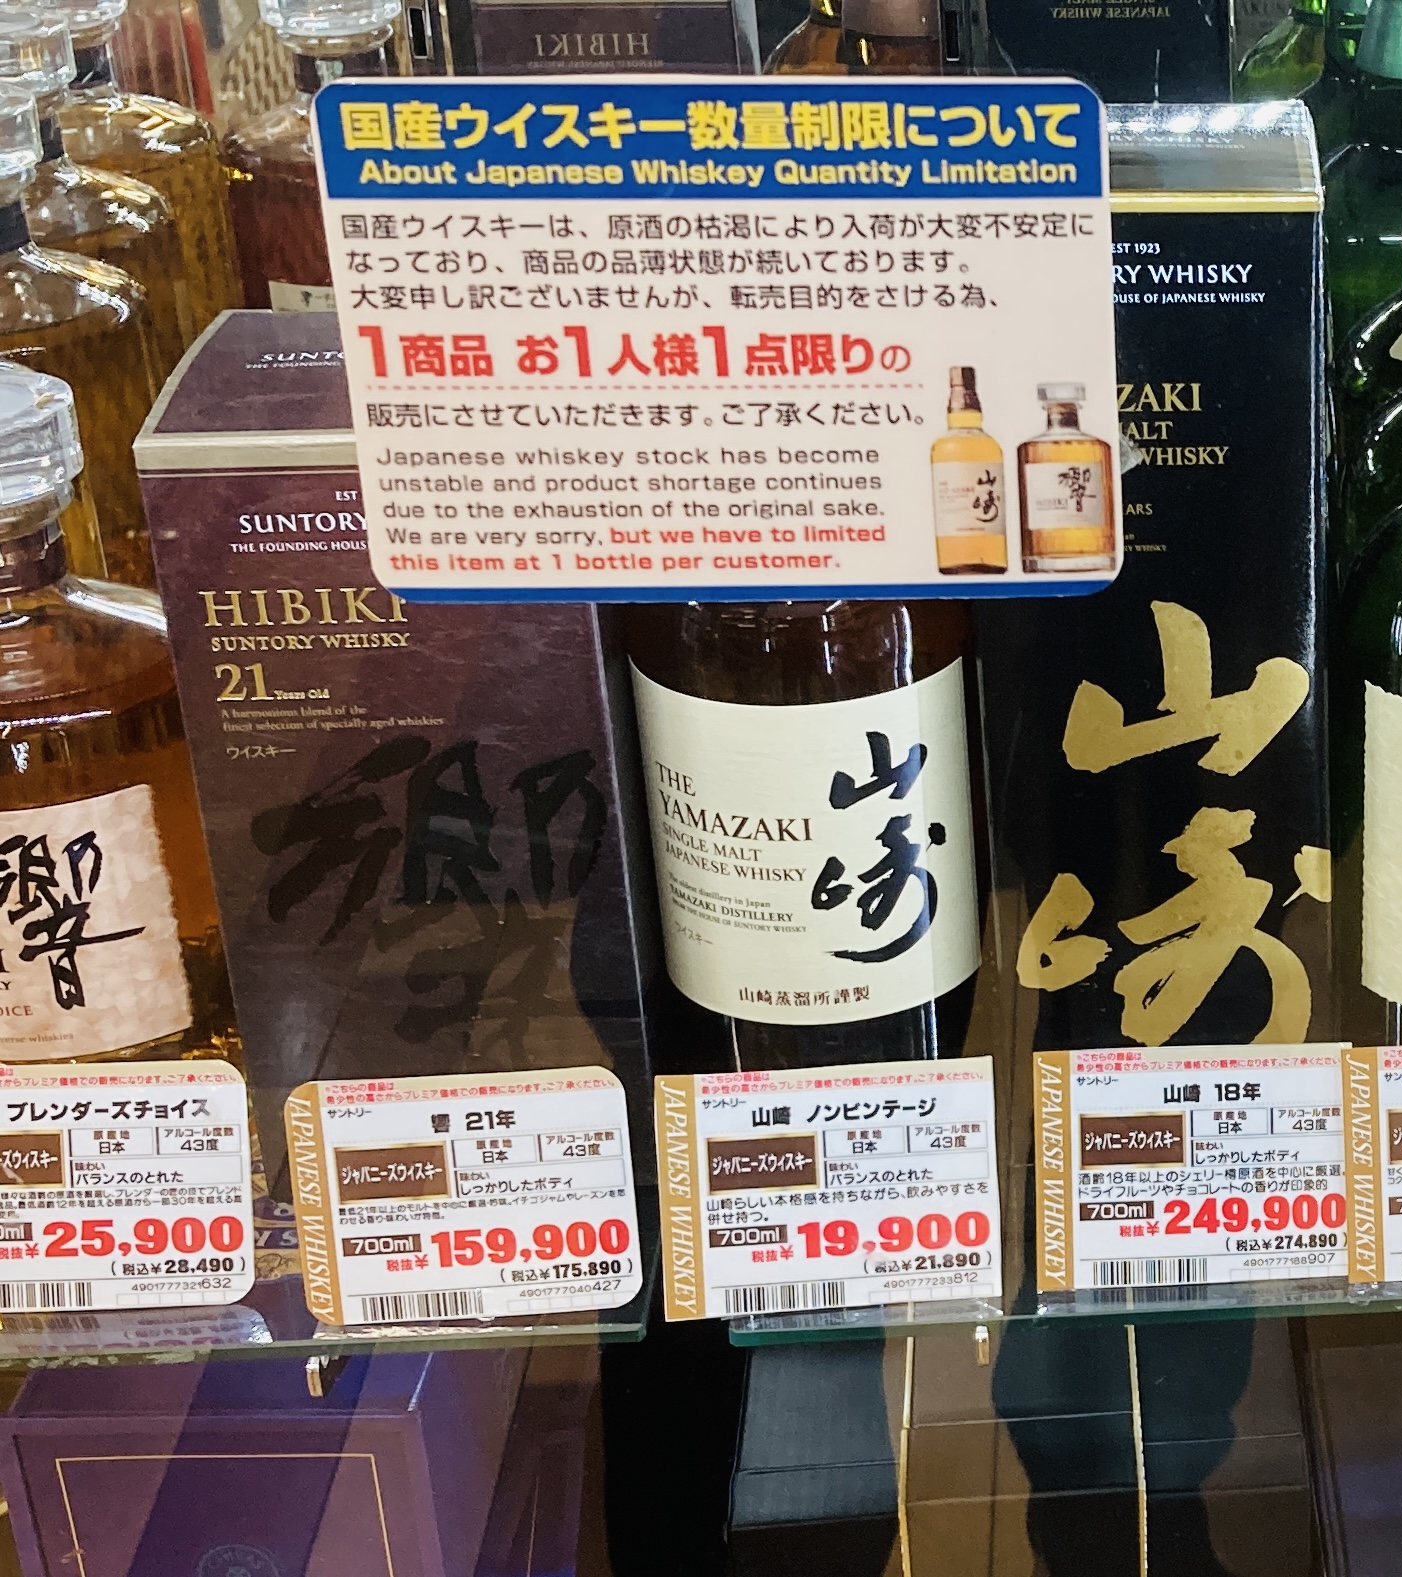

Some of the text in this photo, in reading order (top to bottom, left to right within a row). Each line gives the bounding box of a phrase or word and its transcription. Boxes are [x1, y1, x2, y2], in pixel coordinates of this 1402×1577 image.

[339, 99, 1081, 151] 国産ウイスキー数量制限について
[359, 158, 1077, 187] About Japanese Whiskey Quantity Limitation
[341, 212, 1094, 241] 国産ウイスキーは、原酒の枯渇により入荷が大変不安定に
[1133, 242, 1161, 255] 1923
[346, 248, 970, 275] なっており、商品の品薄状態が続いております。
[1147, 264, 1253, 285] WHISKY
[351, 283, 998, 310] 大変申し訳ございませんが、転売目的をさける為、
[358, 325, 912, 378] 1商品 お1人様1点限りの
[366, 402, 925, 428] 販売にさせていただきます。ご了承ください。
[376, 446, 880, 468] Japanese whiskey stock has become
[379, 473, 882, 494] unstable and product shortage continues
[383, 499, 885, 519] due to the exhaustion of the original sake.
[386, 524, 886, 548] We are very sorry, but we have to limited
[390, 552, 841, 573] this item at 1 bottle per customer.
[198, 586, 409, 628] HIBIKI
[211, 632, 411, 652] SUNTORY WHISKY
[215, 662, 275, 703] 21
[226, 745, 297, 761] ウイスキー
[654, 760, 697, 797] THE
[657, 788, 814, 842] YAMAZAKI
[713, 842, 763, 863] MALT
[810, 730, 948, 964] 山崎
[665, 840, 807, 882] JAPANESE WHISKY
[1163, 1082, 1261, 1104] 山崎 18年
[7, 1098, 212, 1123] ブレンダーズチョイス
[465, 1109, 516, 1132] 21年
[752, 1097, 937, 1128] 山崎 ノンビンテージ
[851, 1141, 878, 1155] 日本
[929, 1135, 968, 1150] 43度
[1038, 1056, 1067, 1287] JAPANESE WHISKEY
[459, 1175, 574, 1197] しっかりしたボディ
[289, 1097, 336, 1324] JAPANESE WHISKEY
[1089, 1203, 1148, 1220] 700ml
[1163, 1192, 1347, 1235] 249,900
[43, 1215, 244, 1258] 25,900
[353, 1236, 414, 1255] 700ml
[430, 1218, 631, 1268] 159,900
[716, 1227, 781, 1246] 700ml
[796, 1209, 991, 1259] 19,900
[131, 1277, 232, 1292] 4901777321632
[519, 1278, 622, 1299] 4901777040427
[882, 1271, 979, 1290] 4901777233812
